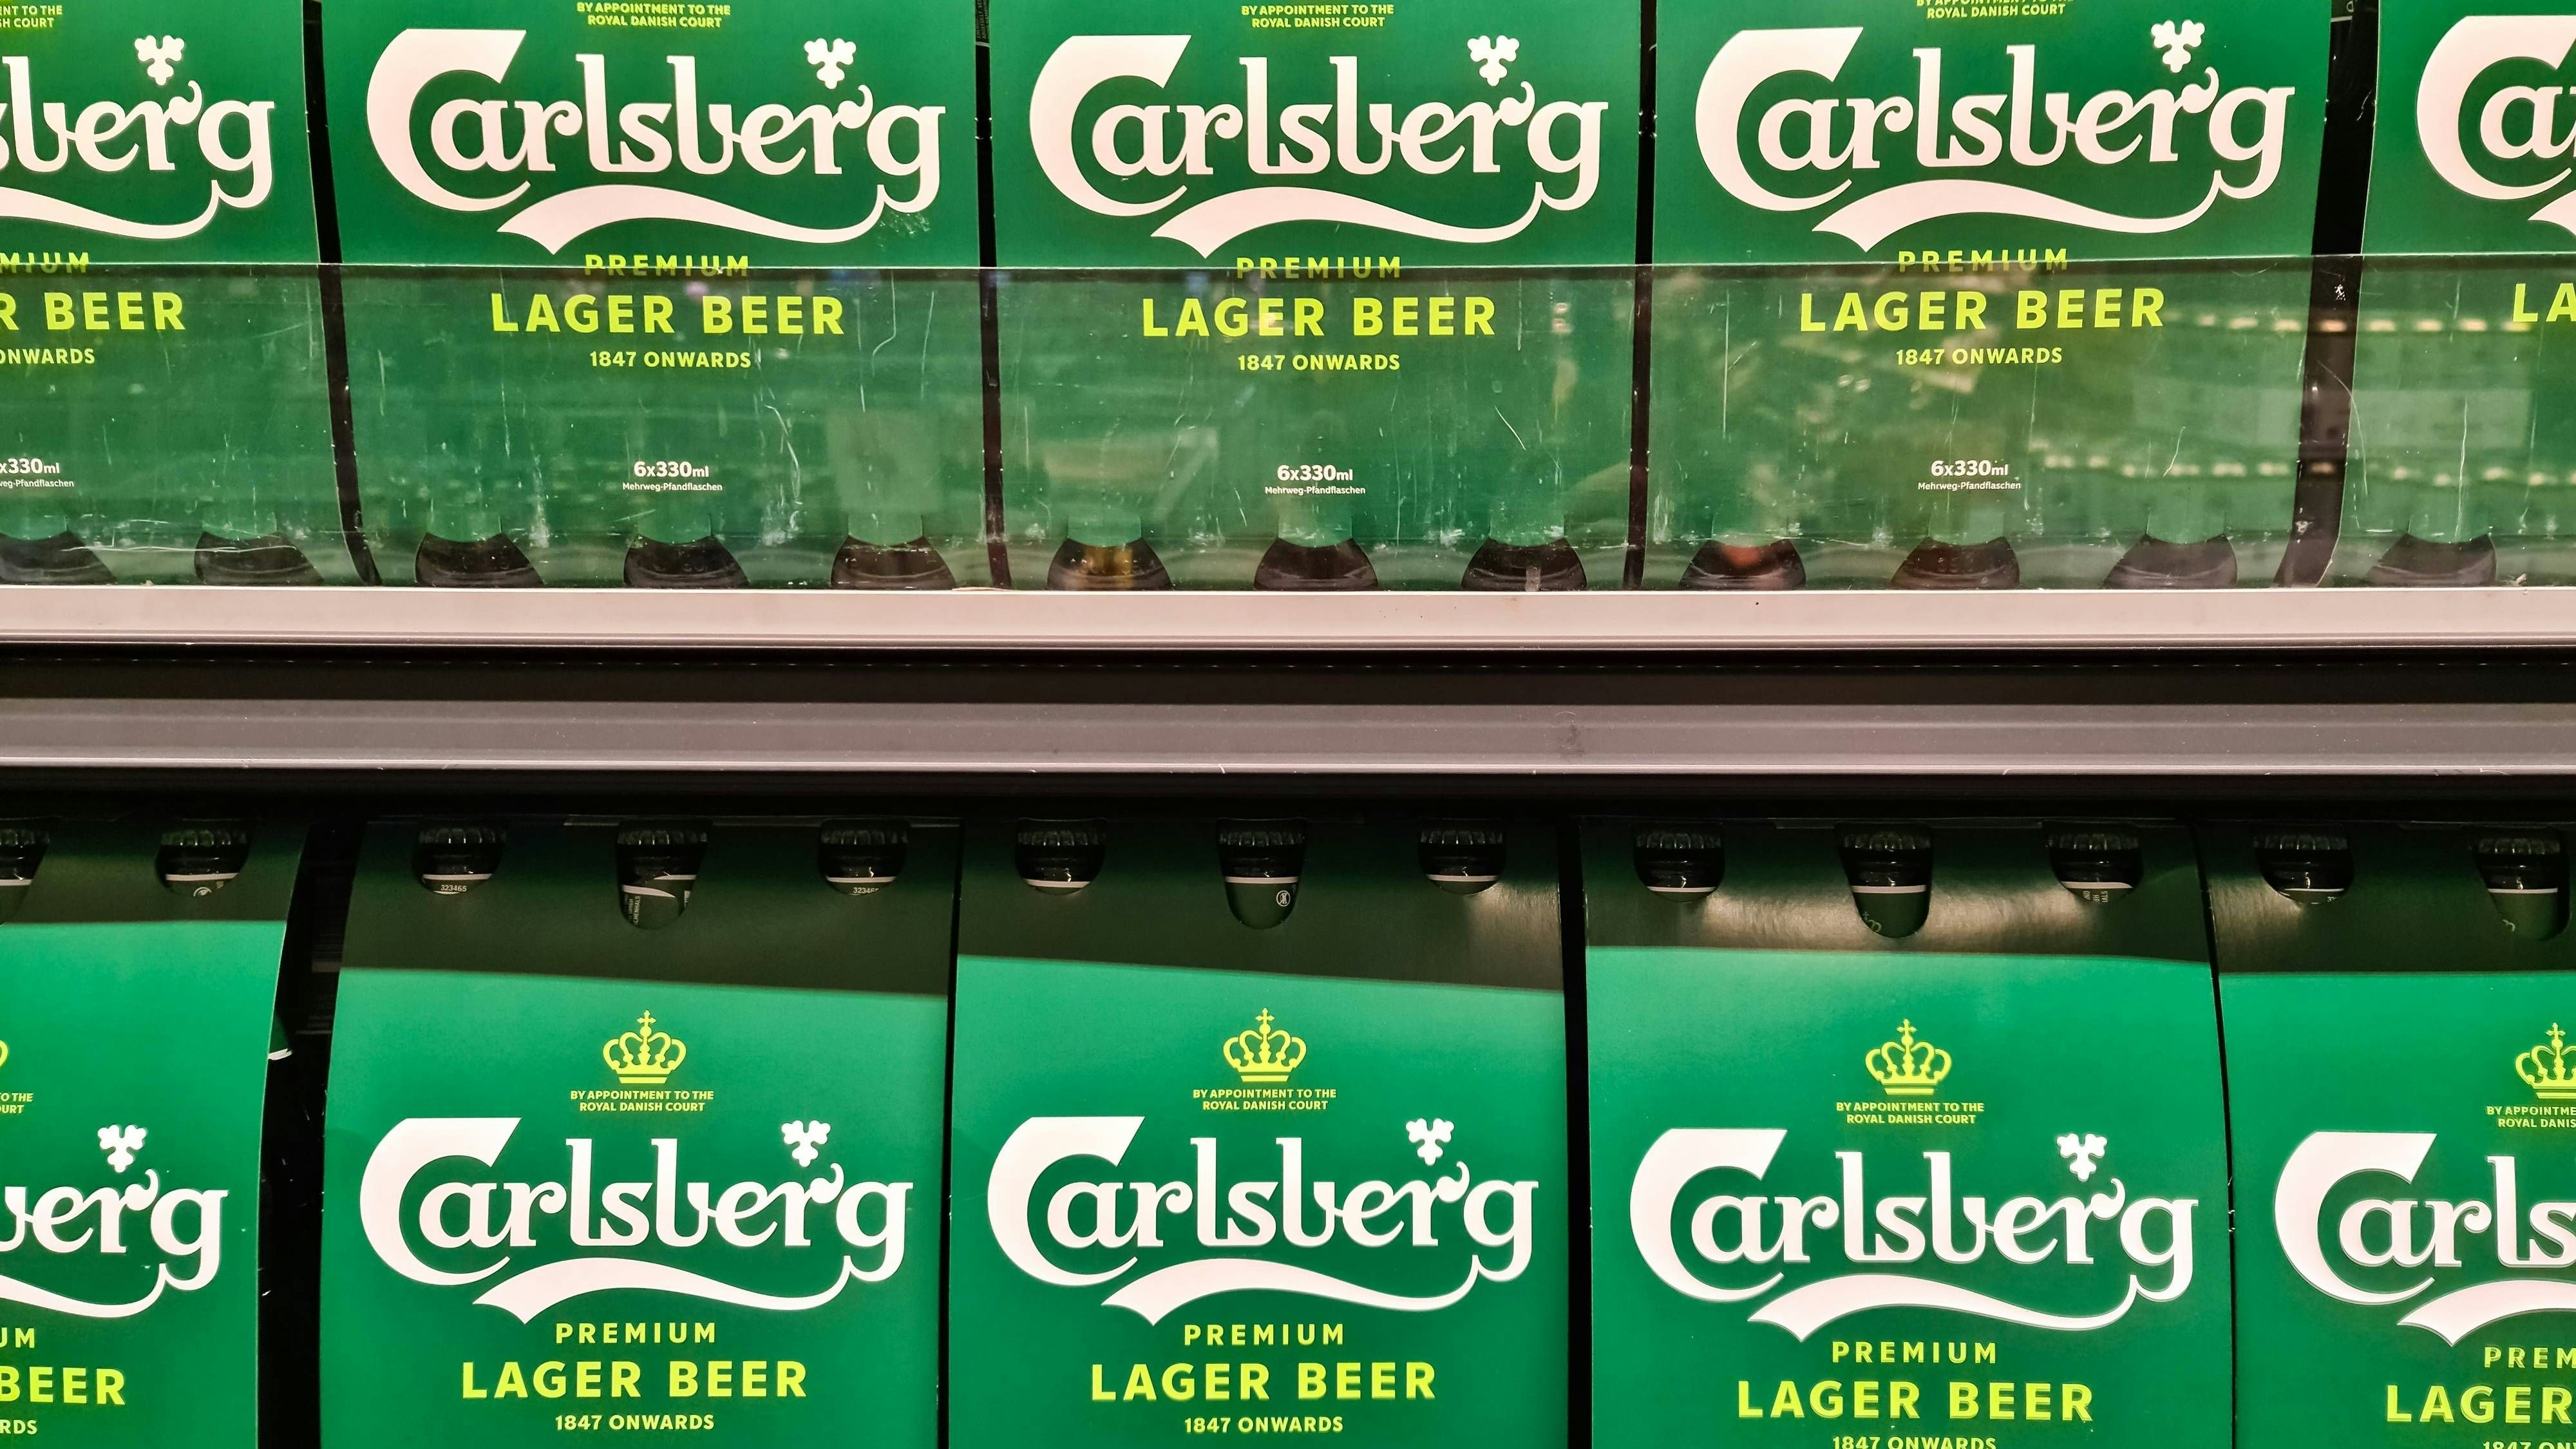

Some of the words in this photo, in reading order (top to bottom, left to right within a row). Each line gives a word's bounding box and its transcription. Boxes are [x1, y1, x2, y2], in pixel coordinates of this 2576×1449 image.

[22, 6, 37, 15] TO
[41, 6, 62, 15] THE
[577, 3, 593, 12] BY
[595, 3, 685, 15] APPOINTMENT
[687, 5, 705, 15] TO
[707, 5, 730, 15] THE
[1242, 6, 1257, 15] BY
[1260, 5, 1349, 15] APPOINTMENT
[1351, 5, 1368, 14] TO
[1370, 5, 1394, 14] THE
[1927, 7, 1968, 19] ROYAL
[1971, 6, 2018, 17] DANISH
[2022, 4, 2065, 15] COURT
[14, 17, 54, 28] COURT
[588, 15, 628, 25] ROYAL
[631, 15, 676, 26] DANISH
[679, 17, 722, 27] COURT
[1253, 18, 1291, 28] ROYAL
[1294, 17, 1340, 27] DANISH
[1343, 17, 1385, 26] COURT
[2416, 15, 2576, 200] Ca
[367, 28, 945, 213] Carlsberg
[1030, 35, 1609, 216] Carlsberg
[1695, 26, 2295, 211] Carlsberg
[0, 56, 274, 208] berg
[584, 254, 749, 276] PREMIUM
[1236, 257, 1400, 279] PREMIUM
[1899, 249, 2067, 272] PREMIUM
[44, 292, 185, 329] BEER
[1801, 292, 1986, 331] LAGER
[2017, 289, 2163, 328] BEER
[2512, 283, 2576, 322] LA
[492, 294, 674, 332] LAGER
[703, 296, 844, 334] BEER
[1144, 298, 1324, 336] LAGER
[1354, 297, 1494, 335] BEER
[591, 352, 636, 366] 1847
[645, 352, 750, 367] ONWARDS
[1238, 355, 1285, 370] 1847
[1293, 355, 1399, 370] ONWARDS
[1897, 349, 1945, 365] 1847
[1952, 348, 2063, 364] ONWARDS
[634, 461, 708, 477] 6x330ml
[1278, 465, 1352, 480] 6x330ml
[1931, 460, 2008, 476] 6x330ml
[623, 482, 722, 491] Mehrweg-Pfandflaschen
[1265, 486, 1365, 495] Mehrweg-Pfandflaschen
[1918, 482, 2020, 491] Mehrweg-Pfandflaschen
[0, 1093, 10, 1101] O
[12, 1093, 33, 1102] THE
[571, 1091, 585, 1099] BY
[587, 1091, 671, 1099] APPOINTMENT
[674, 1090, 690, 1099] TO
[692, 1091, 714, 1099] THE
[1210, 1090, 1293, 1098] APPOINTMENT
[0, 1104, 24, 1113] URT
[580, 1103, 616, 1111] ROYAL
[620, 1103, 662, 1111] DANISH
[665, 1103, 705, 1111] COURT
[1203, 1101, 1239, 1110] ROYAL
[1244, 1101, 1285, 1110] DANISH
[1837, 1103, 1851, 1111] BY
[1854, 1103, 1940, 1112] APPOINTMENT
[1962, 1103, 1984, 1112] THE
[2487, 1106, 2502, 1115] BY
[1847, 1115, 1884, 1123] ROYAL
[1888, 1115, 1932, 1123] DANISH
[1935, 1115, 1975, 1123] COURT
[2498, 1119, 2537, 1127] ROYAL
[359, 1117, 913, 1285] Carlsberg
[987, 1116, 1539, 1286] Carlsberg
[1629, 1128, 2199, 1302] Carlsberg
[556, 1323, 714, 1343] PREMIUM
[1185, 1324, 1343, 1345] PREMIUM
[1833, 1341, 1995, 1363] PREMIUM
[0, 1366, 124, 1405] BEER
[463, 1361, 640, 1397] LAGER
[670, 1361, 806, 1396] BEER
[1093, 1363, 1269, 1400] LAGER
[1298, 1363, 1434, 1398] BEER
[1739, 1381, 1919, 1417] LAGER
[1950, 1382, 2092, 1421] BEER
[2387, 1385, 2572, 1423] LAGER
[556, 1416, 601, 1430] 1847
[609, 1415, 714, 1429] ONWARDS
[1185, 1418, 1230, 1432] 1847
[1238, 1417, 1343, 1432] ONWARDS
[1833, 1437, 1880, 1449] 1847
[1888, 1437, 1996, 1449] ONWARDS
